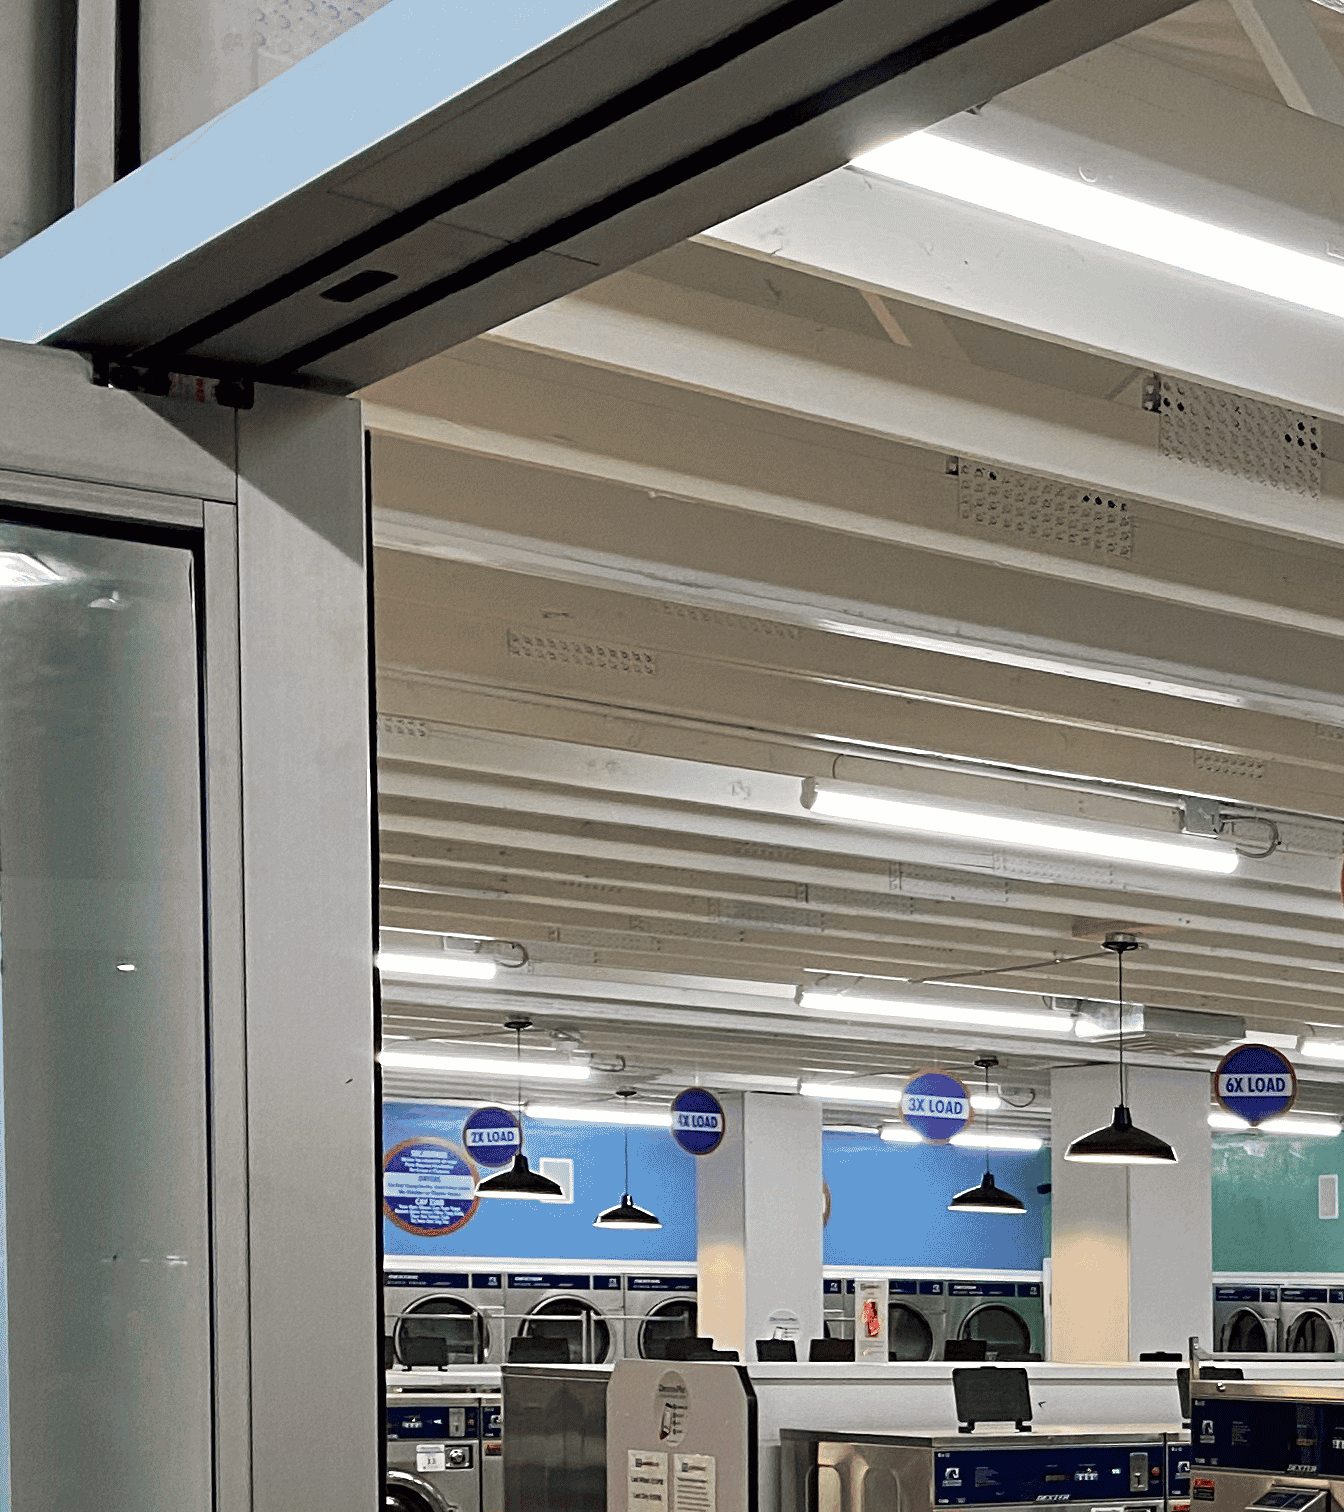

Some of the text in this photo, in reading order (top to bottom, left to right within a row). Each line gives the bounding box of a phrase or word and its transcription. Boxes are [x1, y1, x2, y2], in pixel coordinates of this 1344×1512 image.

[1226, 1077, 1285, 1093] 6X LOAD
[909, 1097, 963, 1114] 3X LOAD
[692, 1115, 718, 1128] LOAD
[471, 1131, 514, 1143] 2X LOAD
[1287, 1464, 1317, 1472] DEXTER
